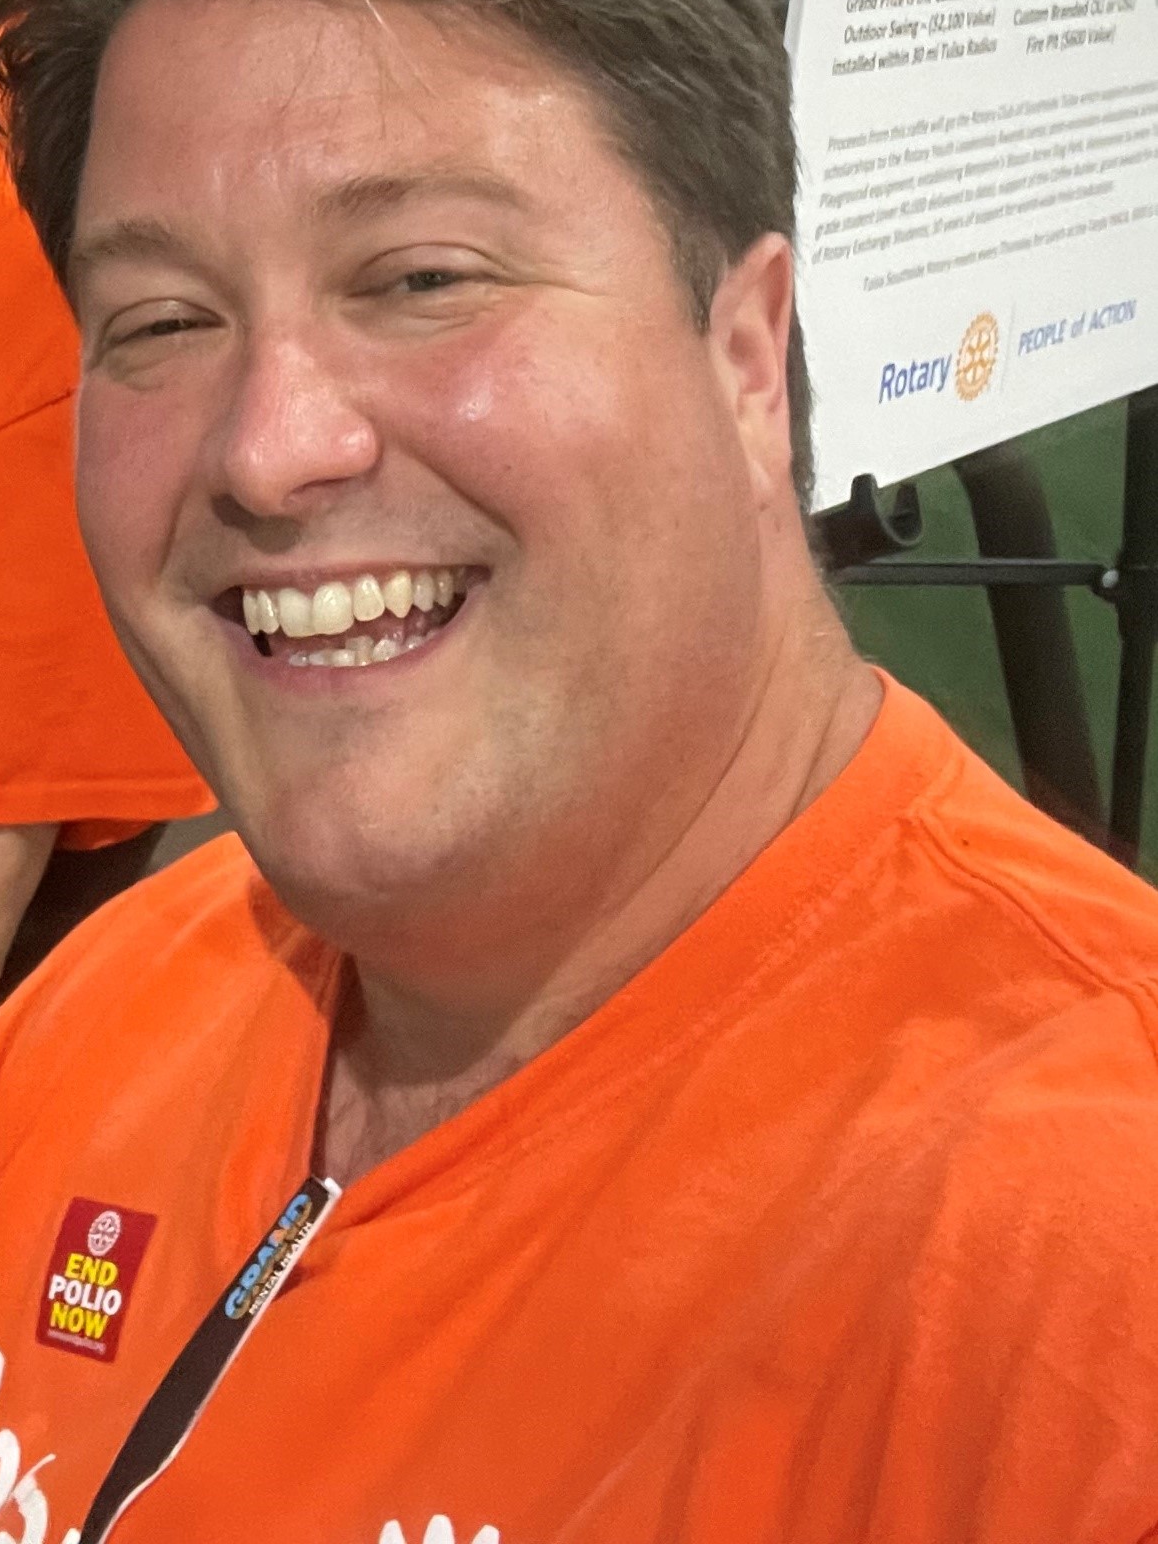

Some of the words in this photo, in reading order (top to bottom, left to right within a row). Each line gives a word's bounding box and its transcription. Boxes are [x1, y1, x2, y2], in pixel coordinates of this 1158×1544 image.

[1018, 318, 1067, 356] PEOPLE
[1071, 311, 1086, 338] of
[1089, 300, 1137, 332] ACTION
[879, 354, 953, 404] Rotary
[64, 1252, 119, 1287] END
[225, 1193, 313, 1320] GRAND
[48, 1273, 123, 1316] POLIO
[50, 1300, 110, 1340] NOW
